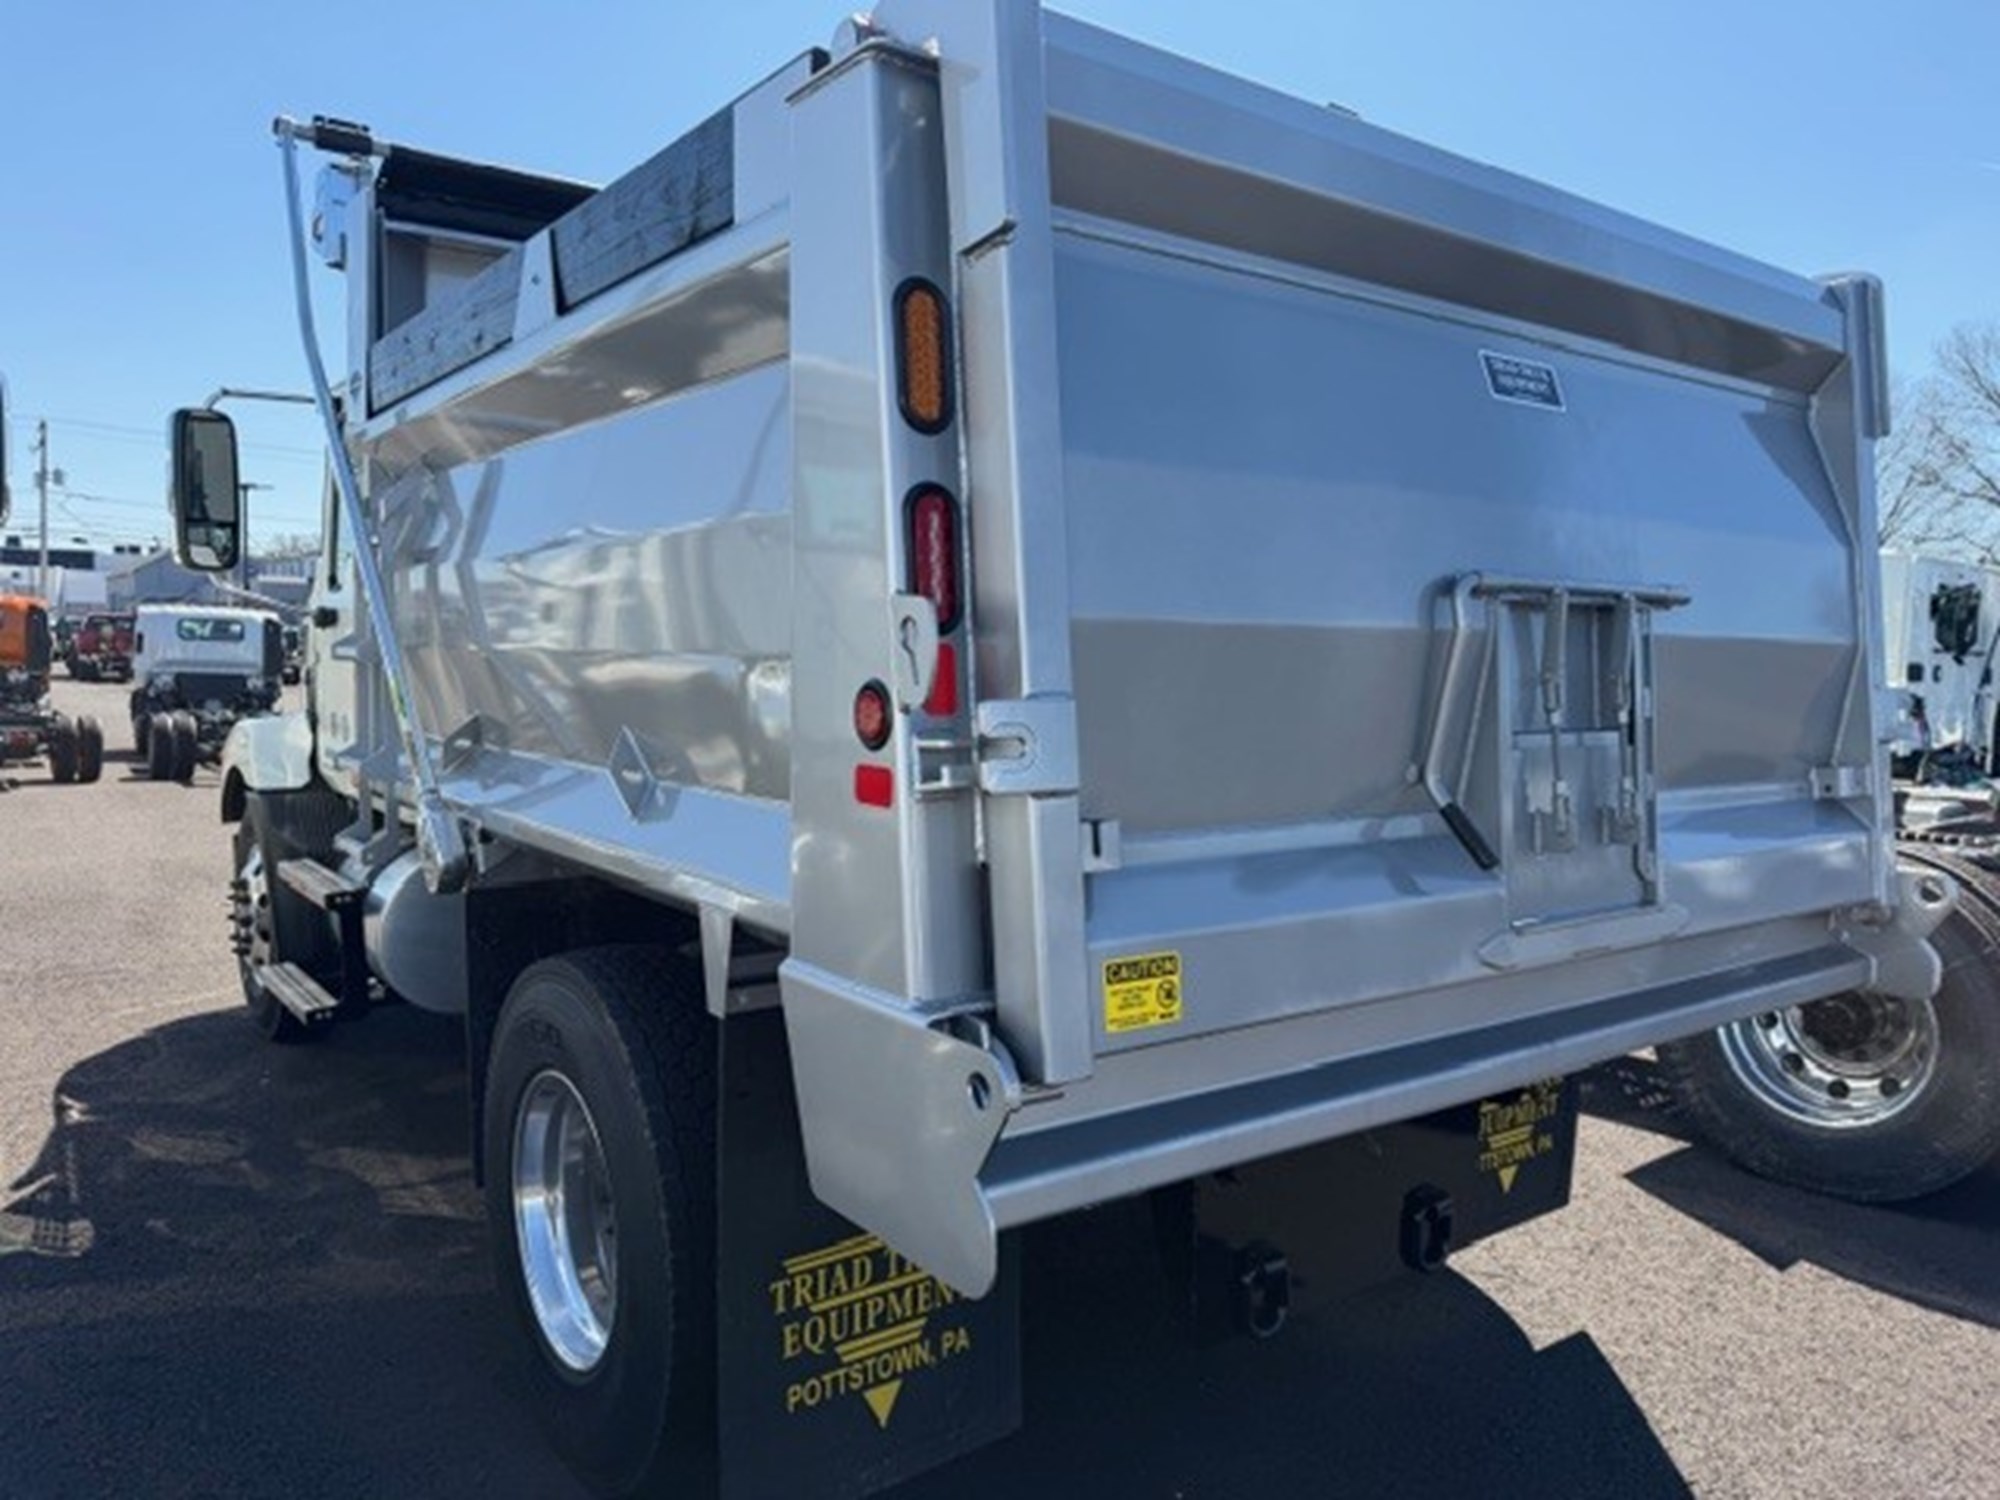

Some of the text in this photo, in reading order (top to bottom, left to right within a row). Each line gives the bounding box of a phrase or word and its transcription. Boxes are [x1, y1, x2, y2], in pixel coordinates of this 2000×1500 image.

[1108, 956, 1178, 983] CAUTION
[769, 1255, 873, 1315] TRIAD
[782, 1278, 955, 1359] EQUIPMEN
[941, 1327, 970, 1359] PA
